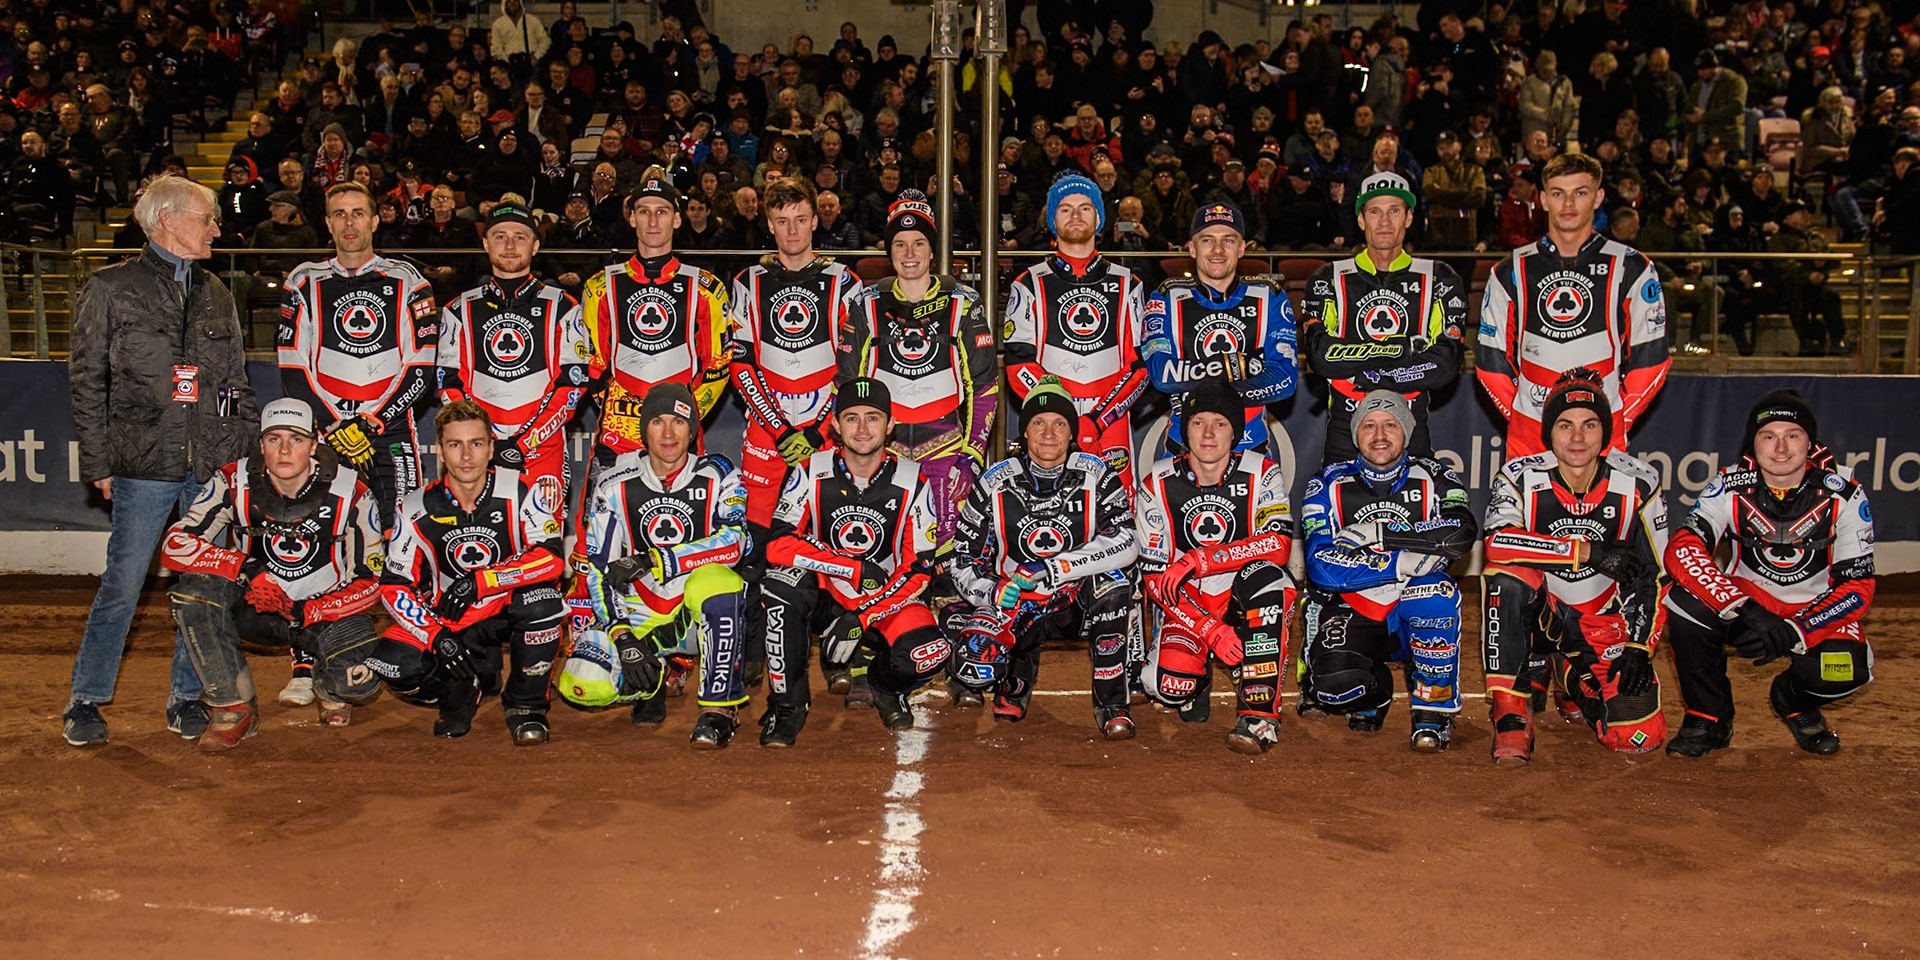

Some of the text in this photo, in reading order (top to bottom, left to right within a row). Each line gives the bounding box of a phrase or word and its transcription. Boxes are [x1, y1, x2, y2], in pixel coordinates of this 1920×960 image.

[904, 203, 928, 214] VUE
[1588, 264, 1608, 276] 18
[673, 282, 684, 292] 5
[818, 282, 824, 290] 1
[1101, 282, 1120, 292] 12
[1401, 282, 1421, 294] 14
[1537, 270, 1594, 290] PETER CRAVEN
[333, 290, 386, 308] PETER CRAVEN
[383, 286, 394, 296] 8
[626, 286, 676, 304] PETER CRAVEN
[770, 286, 820, 302] PETER CRAVEN
[1057, 287, 1110, 304] PETER CRAVEN
[1356, 289, 1410, 306] PETER CRAVEN
[1542, 284, 1558, 300] BELLE
[1576, 285, 1588, 300] ACES
[338, 301, 352, 318] BELLE
[370, 304, 382, 318] ACES
[531, 306, 542, 317] 6
[1062, 299, 1076, 314] BELLE
[1092, 300, 1104, 314] ACES
[1239, 306, 1257, 318] 13
[1360, 302, 1376, 319] BELLE
[1392, 304, 1404, 318] ACES
[482, 313, 534, 331] PETER CRAVEN
[1194, 312, 1247, 330] PETER CRAVEN
[487, 325, 501, 341] BELLE
[518, 326, 530, 341] ACES
[1199, 326, 1214, 342] BELLE
[1230, 328, 1242, 342] ACES
[1540, 325, 1587, 338] MEMORIAL
[338, 341, 382, 354] MEMORIAL
[632, 338, 672, 351] MEMORIAL
[774, 336, 814, 348] MEMORIAL
[1062, 338, 1104, 351] MEMORIAL
[488, 366, 530, 378] MEMORIAL
[892, 364, 936, 376] MEMORIAL
[1162, 359, 1224, 384] Nice
[1246, 376, 1293, 398] CONTACT
[738, 370, 782, 429] BROWNING
[1228, 484, 1248, 496] 15
[1724, 478, 1758, 489] HOCKS
[687, 488, 706, 500] 10
[1400, 490, 1422, 502] 16
[638, 497, 694, 514] PETER CRAVEN
[885, 499, 898, 511] 4
[1067, 500, 1083, 512] 11
[1181, 494, 1236, 513] PETER CRAVEN
[1354, 503, 1376, 520] PETER
[1378, 501, 1411, 518] CRAVEN
[318, 506, 331, 519] 2
[490, 511, 504, 524] 3
[644, 510, 658, 526] BELLE
[676, 512, 689, 526] ACES
[831, 506, 886, 524] PETER CRAVEN
[1187, 508, 1200, 524] BELLE
[1218, 508, 1232, 522] ACES
[1604, 506, 1616, 518] 9
[835, 516, 851, 531] BELLE
[868, 520, 880, 534] ACES
[1023, 524, 1038, 539] BELLE
[1054, 523, 1068, 538] ACES
[1548, 518, 1606, 534] PETER CRAVEN
[442, 526, 498, 542] PETER CRAVEN
[1228, 536, 1279, 554] KRAJEWSKI
[1495, 536, 1554, 550] METAL-MART
[1071, 552, 1105, 568] KVP 450
[266, 562, 313, 578] MEMORIAL
[1676, 548, 1730, 603] SHOCKS
[1689, 546, 1743, 597] HAGON
[1757, 566, 1810, 582] MEMORIAL
[1810, 595, 1858, 627] ENGINEERING
[1262, 616, 1278, 626] N
[1488, 585, 1501, 671] EUROPEL
[914, 642, 947, 660] CBS
[1246, 642, 1278, 652] ROCK OIL
[918, 653, 948, 672] BINS
[1255, 663, 1275, 674] NEB
[1162, 678, 1195, 690] AMD
[1246, 692, 1270, 702] JHI
